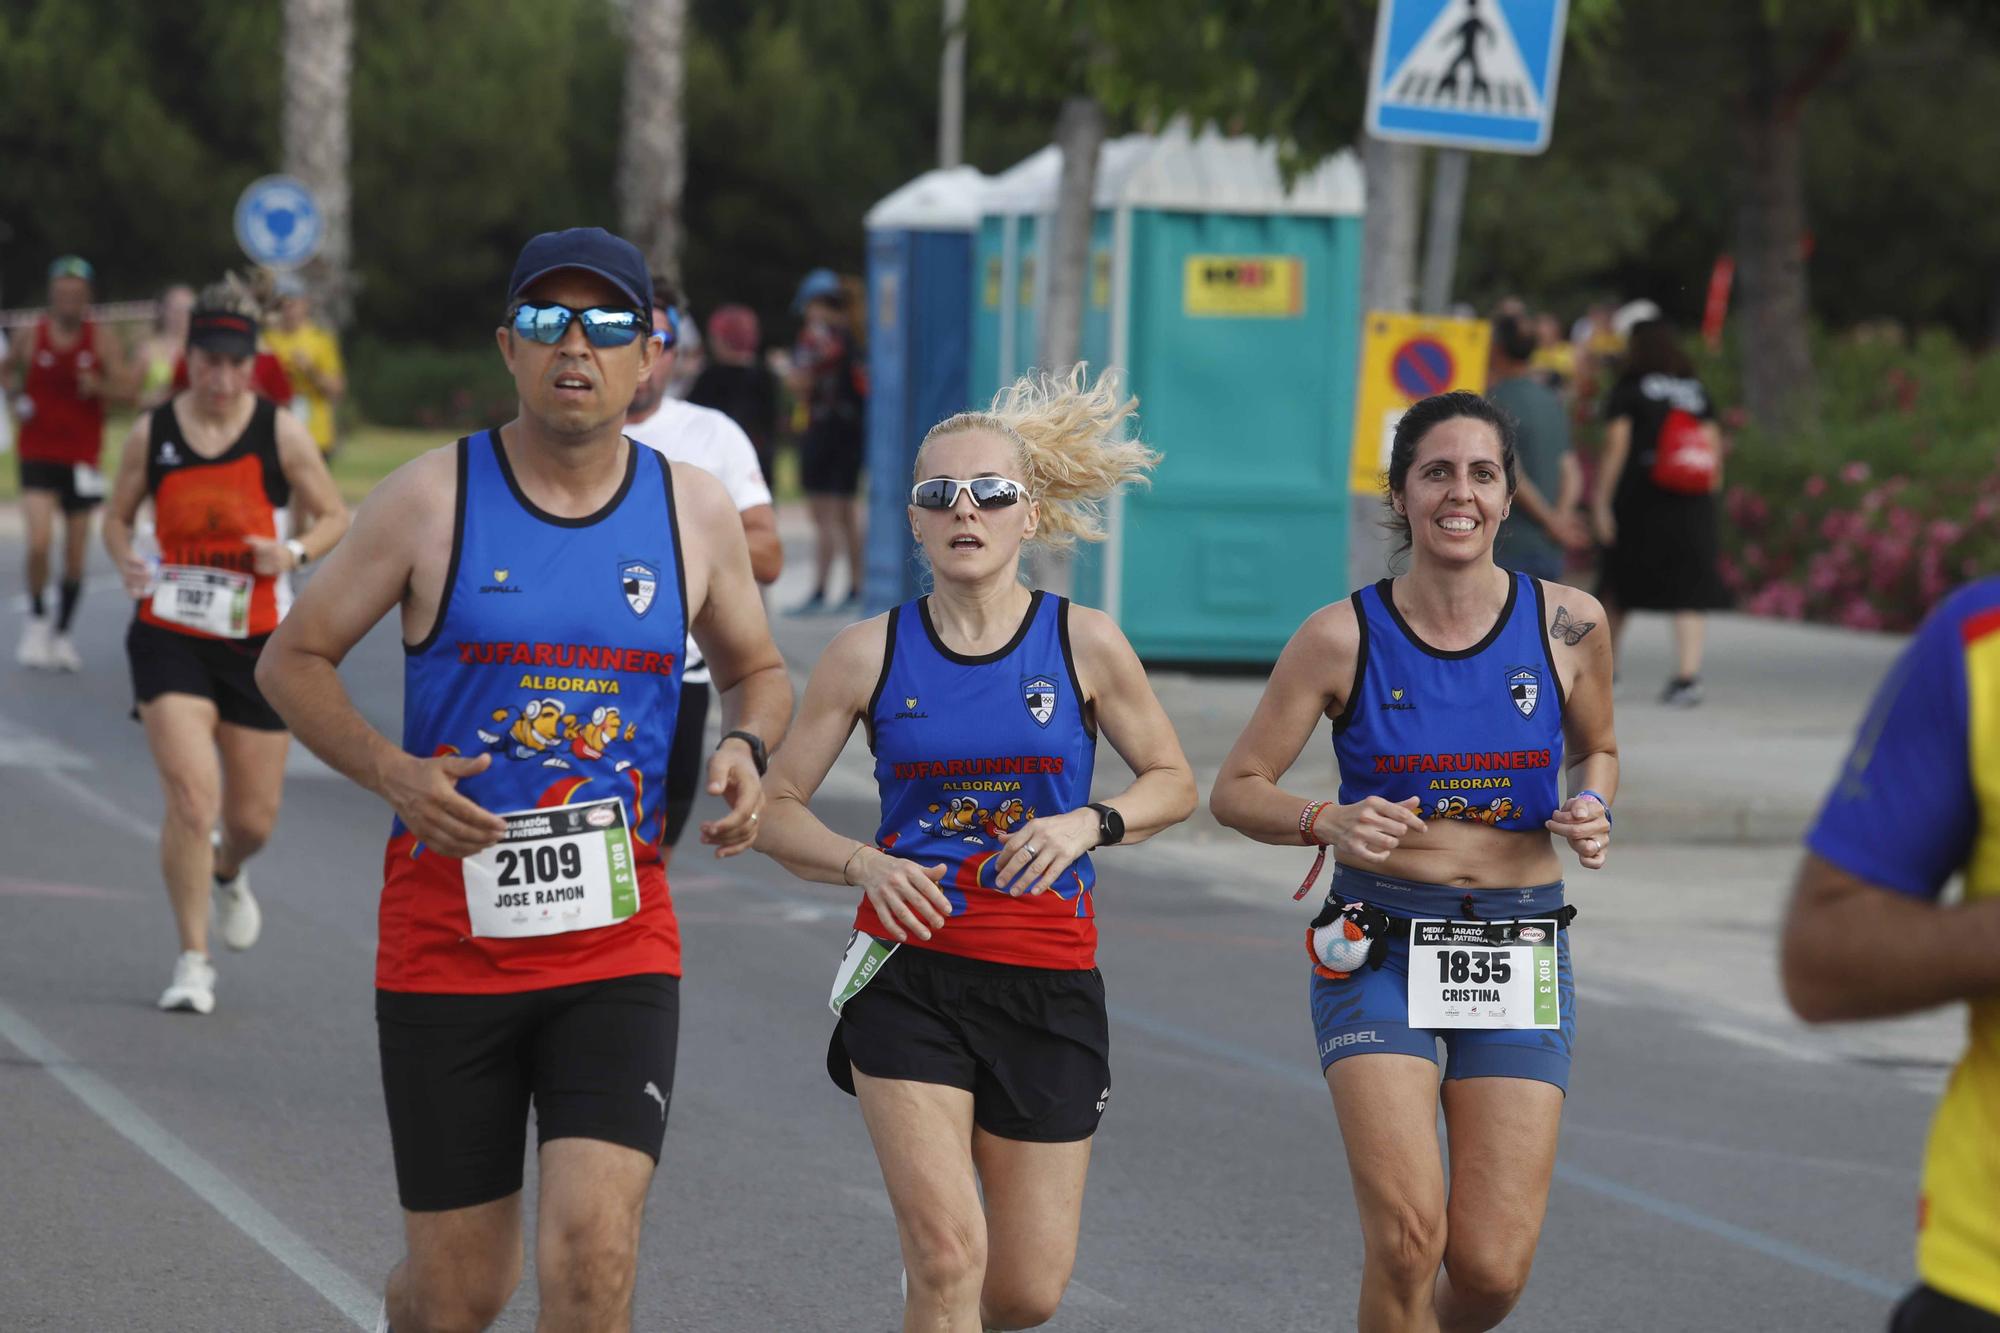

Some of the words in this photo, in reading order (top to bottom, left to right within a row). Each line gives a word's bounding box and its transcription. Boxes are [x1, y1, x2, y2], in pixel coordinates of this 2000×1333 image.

[479, 586, 523, 594] SPALL
[457, 642, 675, 676] XUFARUNNERS
[519, 675, 620, 694] ALBORAYA
[892, 756, 1065, 780] XUFARUNNERS
[1373, 748, 1552, 774] XUFARUNNERS
[942, 781, 1022, 792] ALBORAYA
[1429, 777, 1512, 790] ALBORAYA
[495, 842, 583, 887] 2109
[611, 842, 628, 870] BOX
[615, 874, 629, 885] 3
[494, 892, 530, 908] JOSE
[535, 885, 585, 905] RAMON
[858, 955, 878, 979] BOX
[1436, 950, 1512, 984] 1835
[1539, 959, 1551, 982] BOX
[853, 978, 863, 989] 3
[1442, 988, 1501, 1002] CRISTINA
[1539, 986, 1551, 994] 3
[1319, 1030, 1385, 1058] LURBEL
